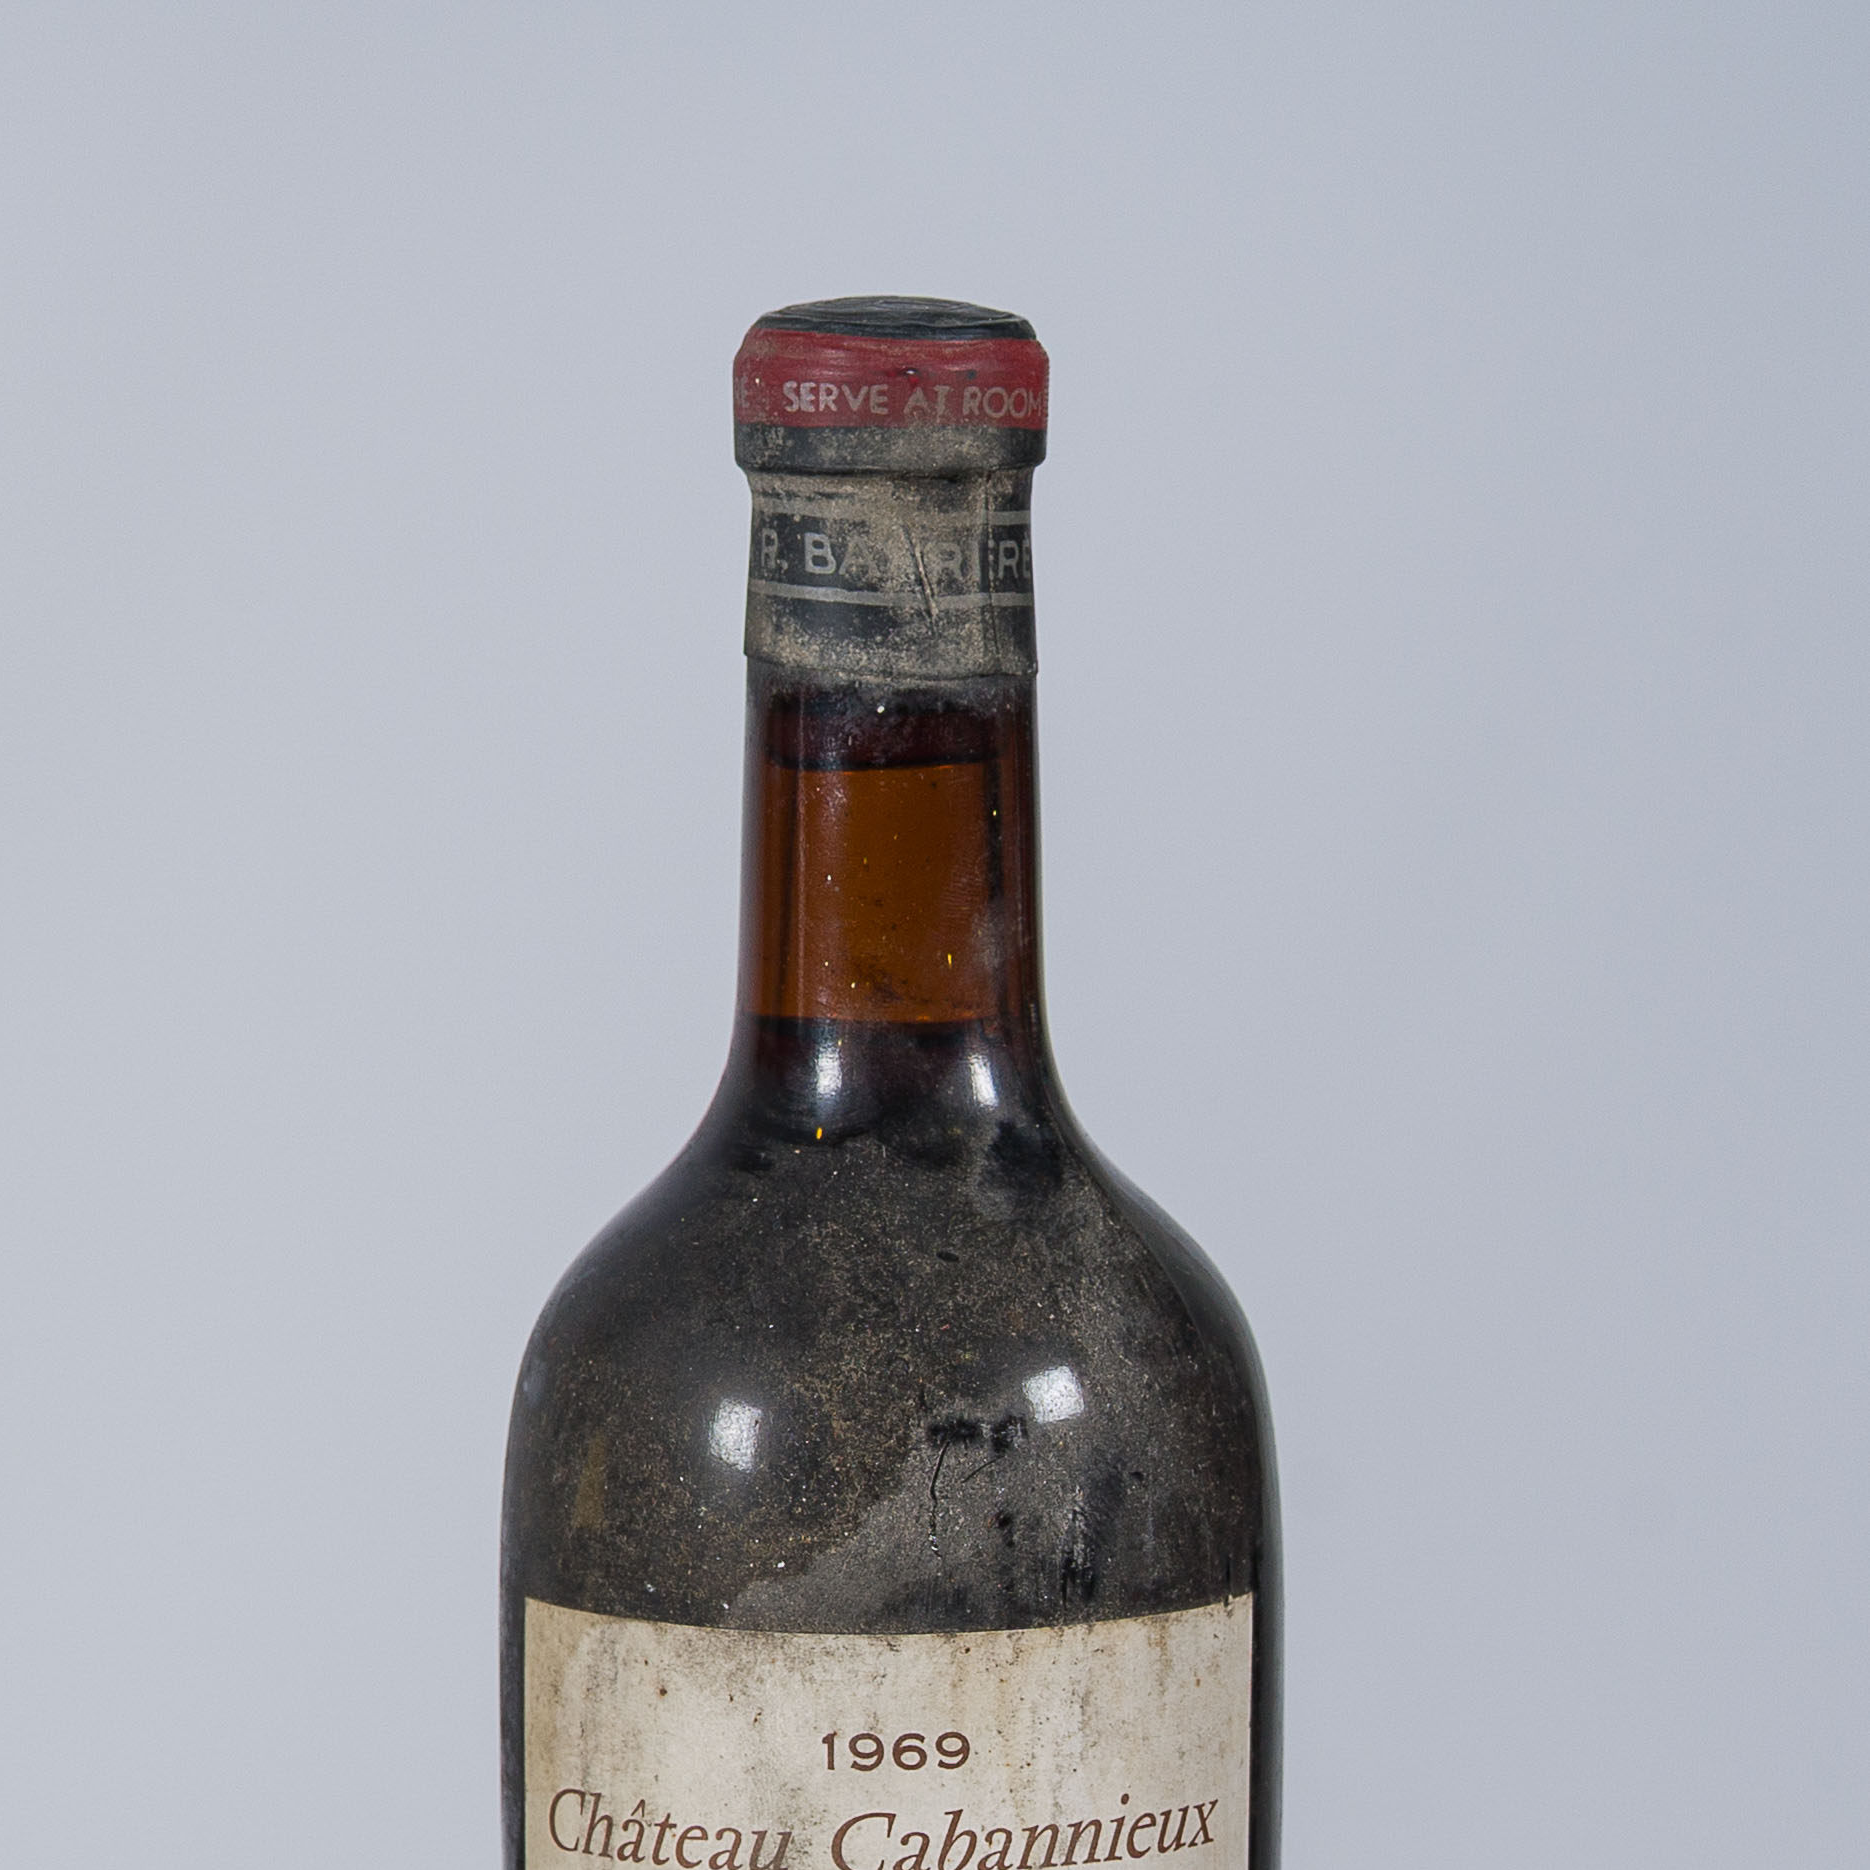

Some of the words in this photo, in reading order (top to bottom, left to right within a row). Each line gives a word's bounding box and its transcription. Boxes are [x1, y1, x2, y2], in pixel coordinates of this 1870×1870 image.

[783, 380, 889, 415] SERVE
[903, 384, 952, 417] AT
[822, 1731, 972, 1772] 1969
